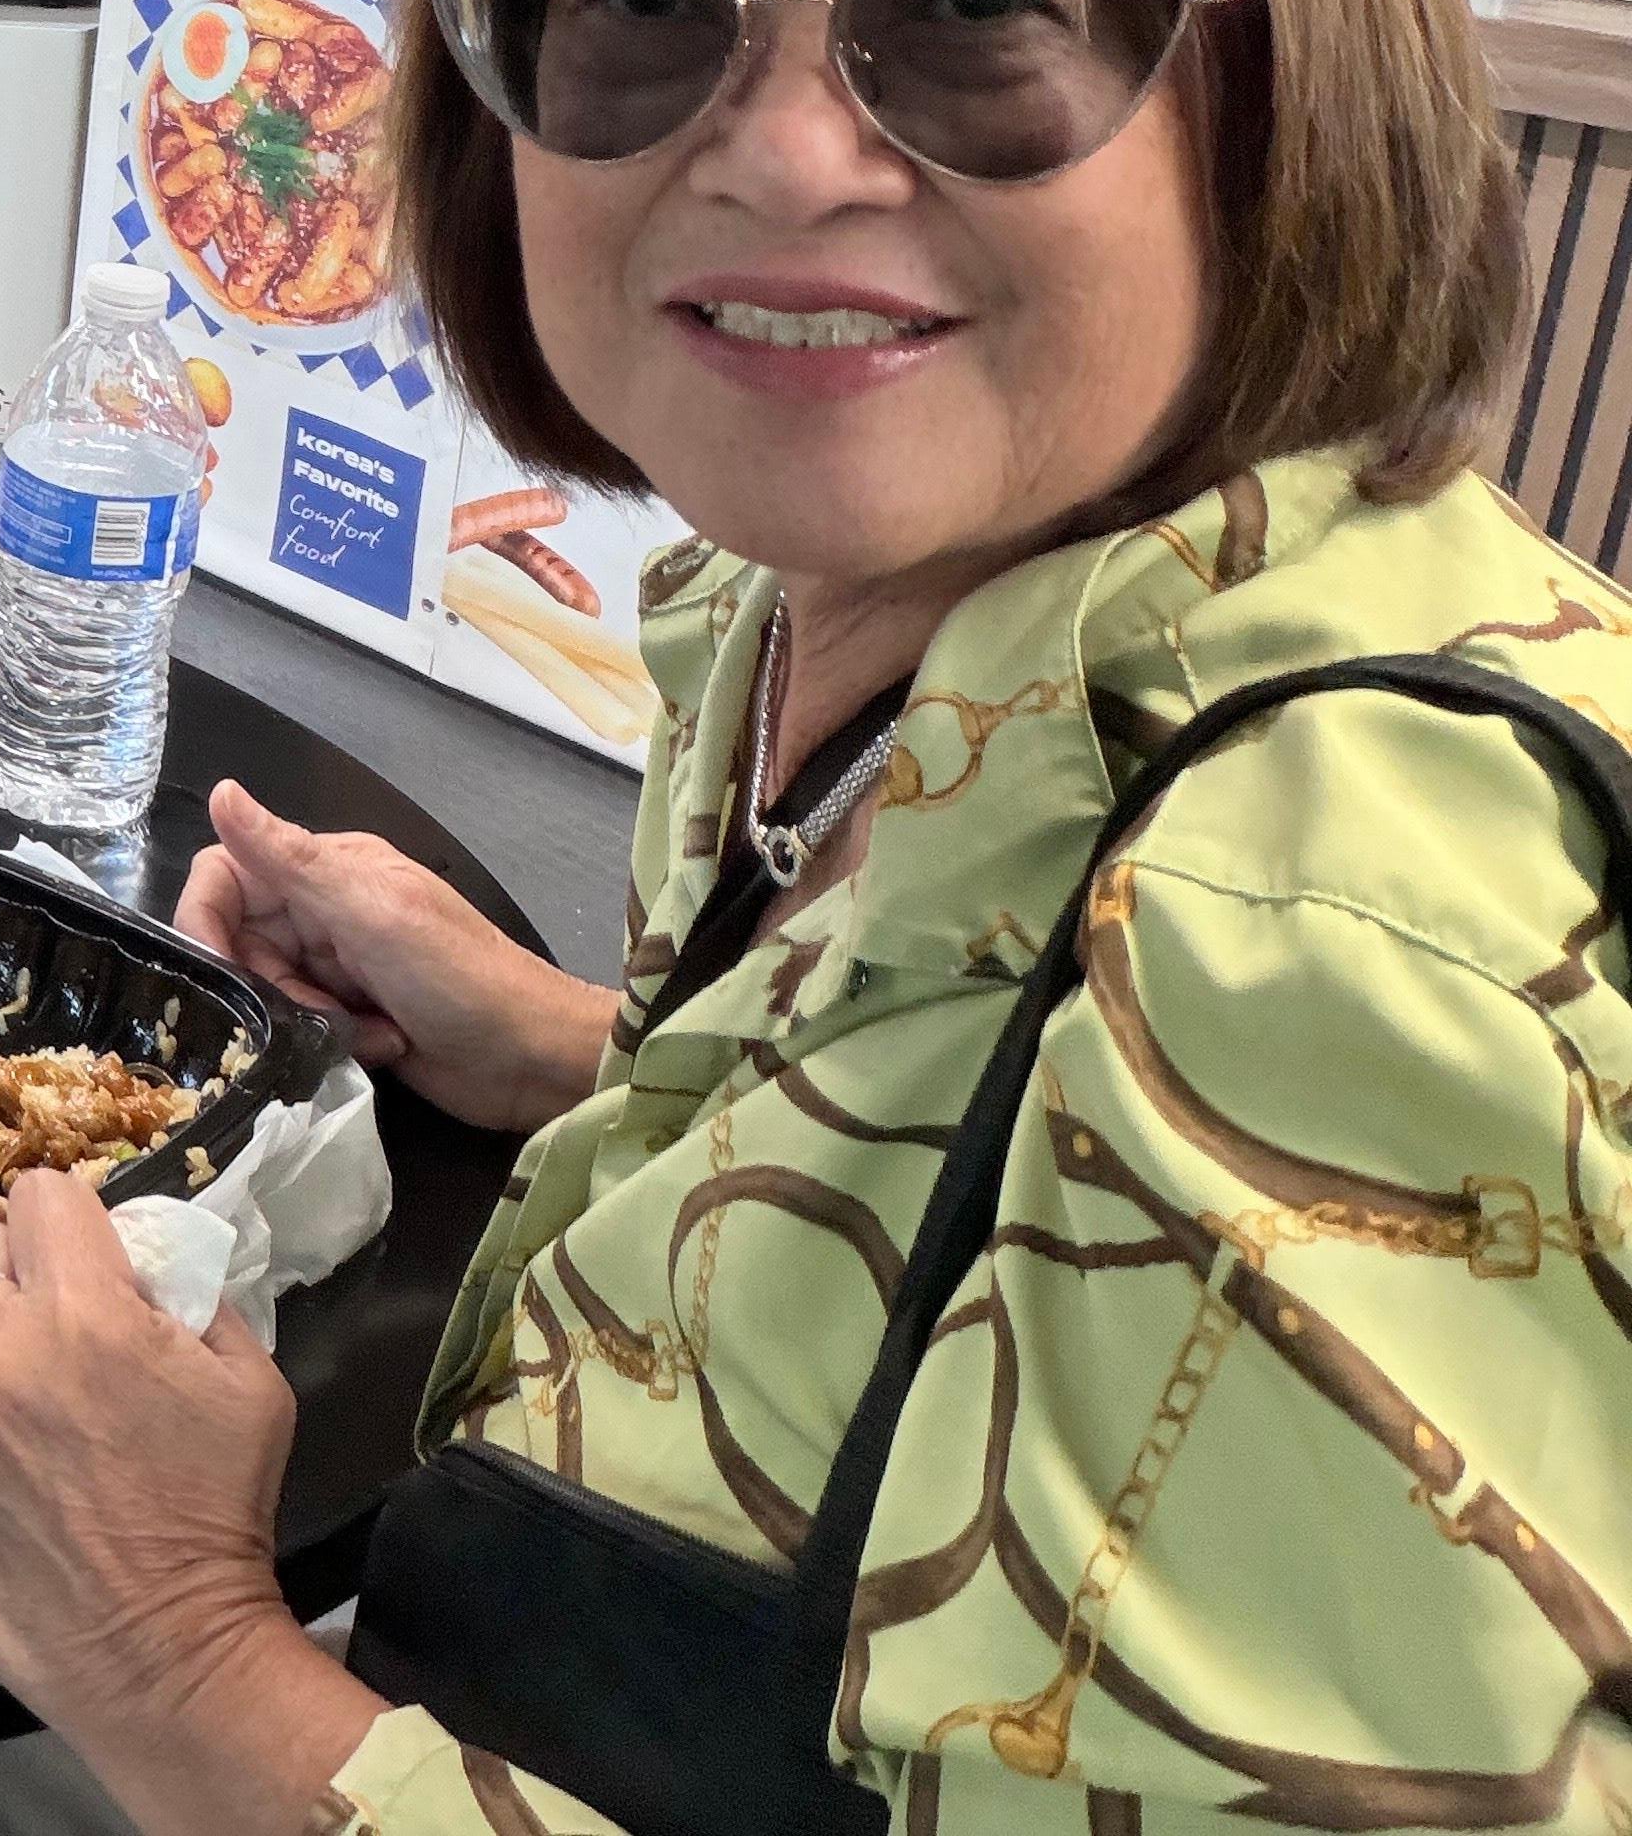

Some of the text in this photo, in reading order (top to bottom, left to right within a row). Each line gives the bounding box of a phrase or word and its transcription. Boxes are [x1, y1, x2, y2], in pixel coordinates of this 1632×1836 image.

[295, 426, 397, 486] korea's
[292, 458, 400, 519] Favorite
[277, 523, 348, 569] food
[289, 493, 385, 550] Comfort
